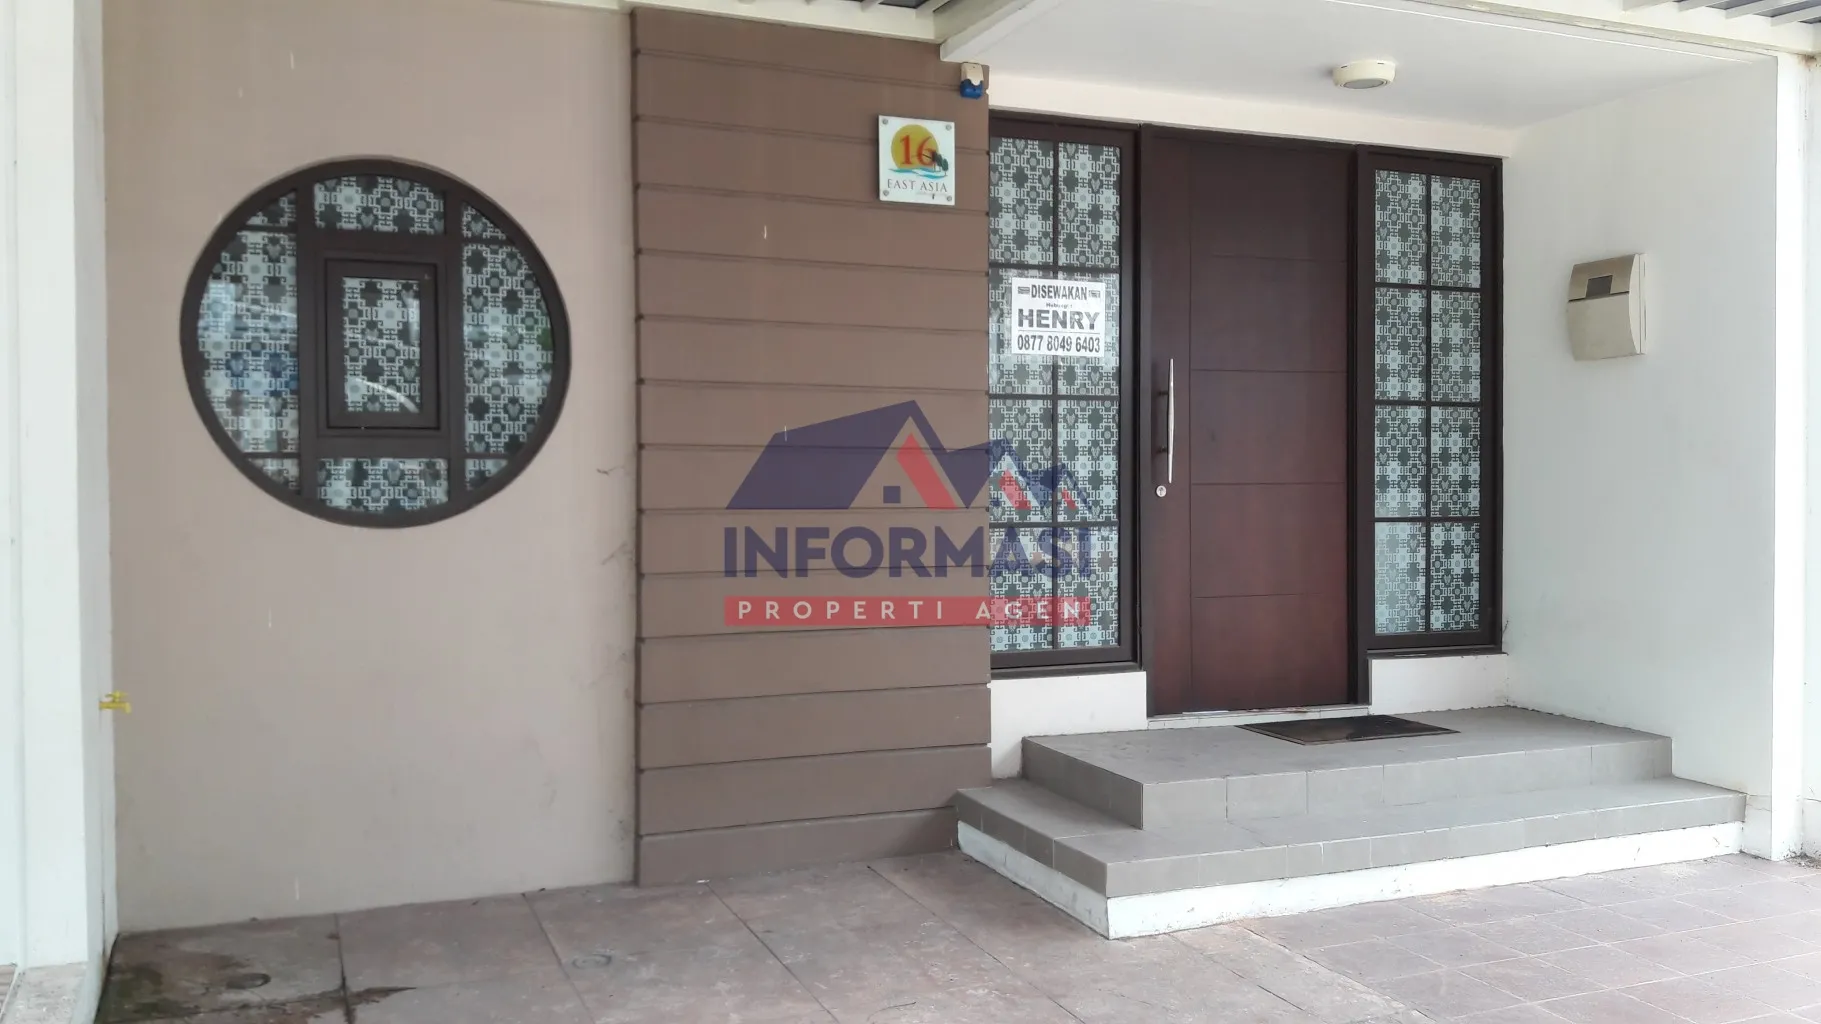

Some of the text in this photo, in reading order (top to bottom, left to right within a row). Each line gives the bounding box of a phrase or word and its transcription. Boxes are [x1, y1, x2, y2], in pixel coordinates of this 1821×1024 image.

[900, 134, 936, 167] 16
[887, 178, 948, 193] EAST ASIA
[1031, 284, 1087, 300] DISEWAKAN
[1017, 308, 1100, 330] HENRY
[1017, 334, 1100, 353] 0877 8049 6403
